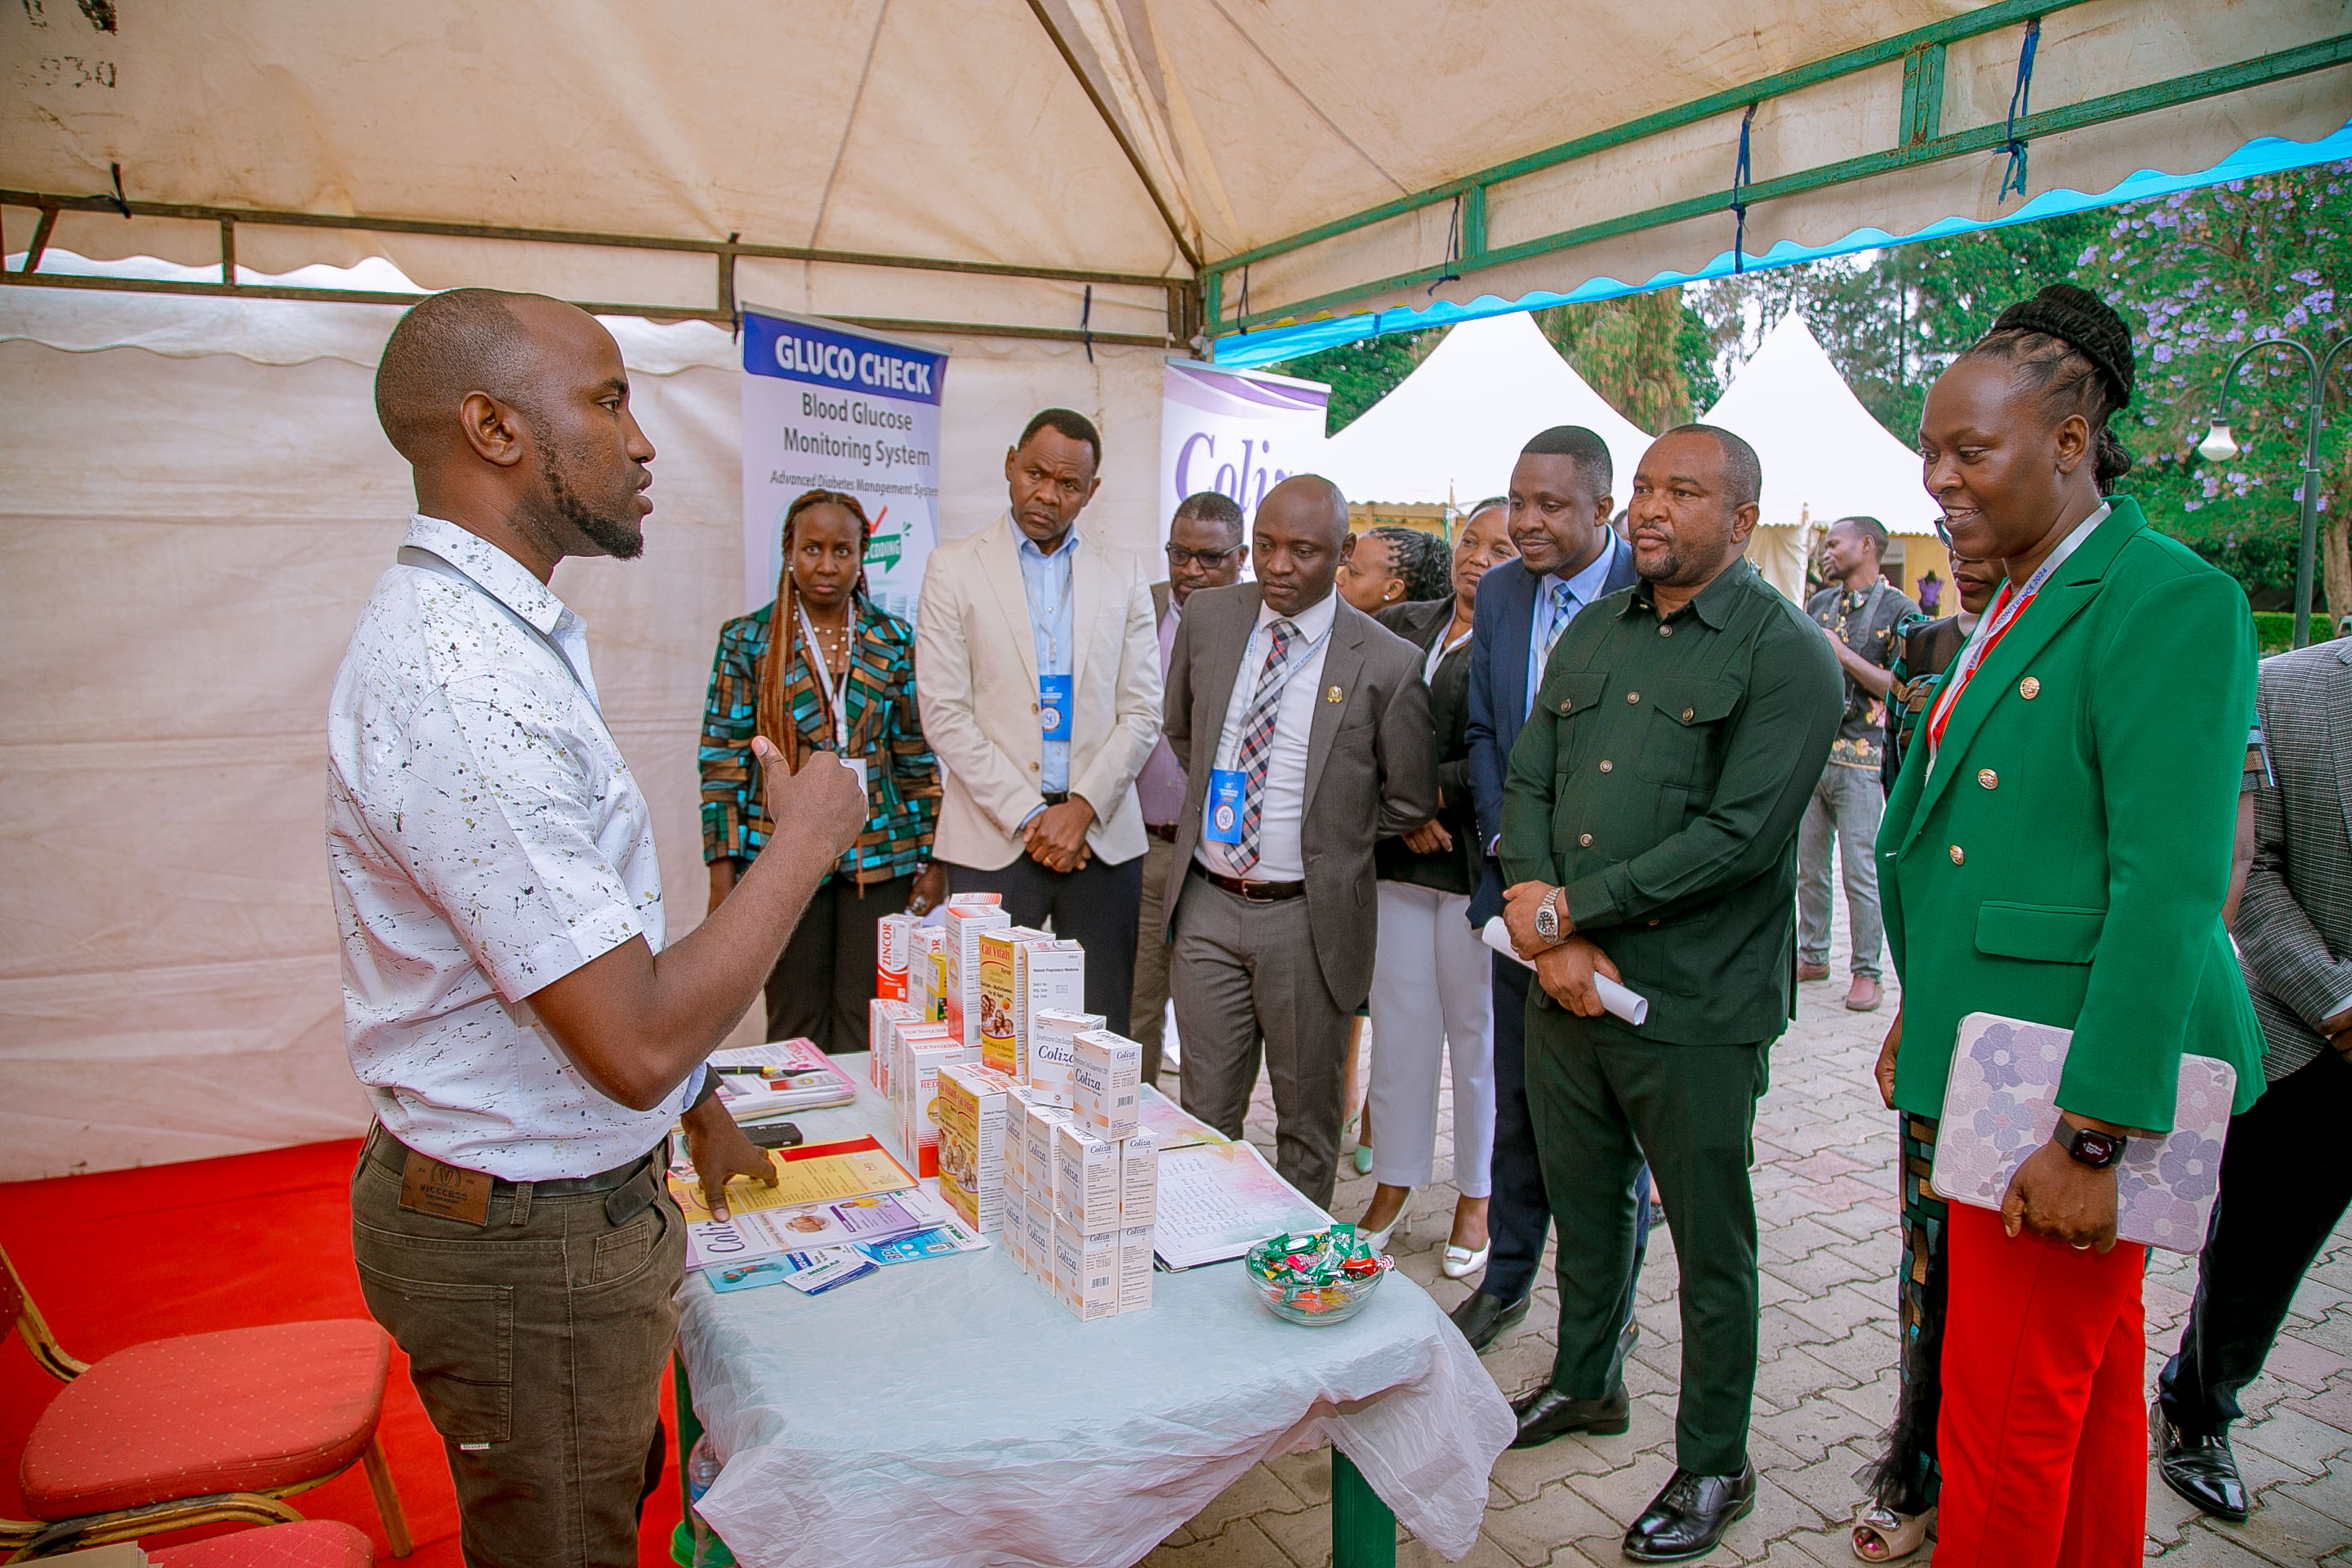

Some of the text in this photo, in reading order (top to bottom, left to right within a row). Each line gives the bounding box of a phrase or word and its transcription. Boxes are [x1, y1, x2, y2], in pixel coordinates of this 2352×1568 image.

[775, 335, 932, 395] GLUCO CHECK
[802, 392, 913, 431] Blood Glucose
[784, 426, 931, 469] Monitoring System
[770, 470, 816, 487] Advanced
[817, 474, 854, 490] Diabetes
[857, 479, 914, 496] Management
[1175, 431, 1294, 514] Coli
[1997, 583, 2035, 625] CONFERENCE
[2032, 568, 2048, 586] 2024
[882, 924, 892, 966] ZINCOR
[982, 943, 1010, 961] Cal Vitals
[1116, 1050, 1135, 1060] Coliza
[1076, 1068, 1101, 1091] Coliza
[1028, 1139, 1046, 1162] Coliza
[1090, 1144, 1111, 1154] Coliza
[1130, 1139, 1151, 1147] Coliza
[1061, 1158, 1079, 1183] Coliza
[695, 1220, 746, 1253] Coli
[1027, 1224, 1045, 1248] Coliza
[1089, 1233, 1110, 1242] Coliza
[1127, 1227, 1146, 1236] Coliza
[1057, 1245, 1077, 1270] Coliza
